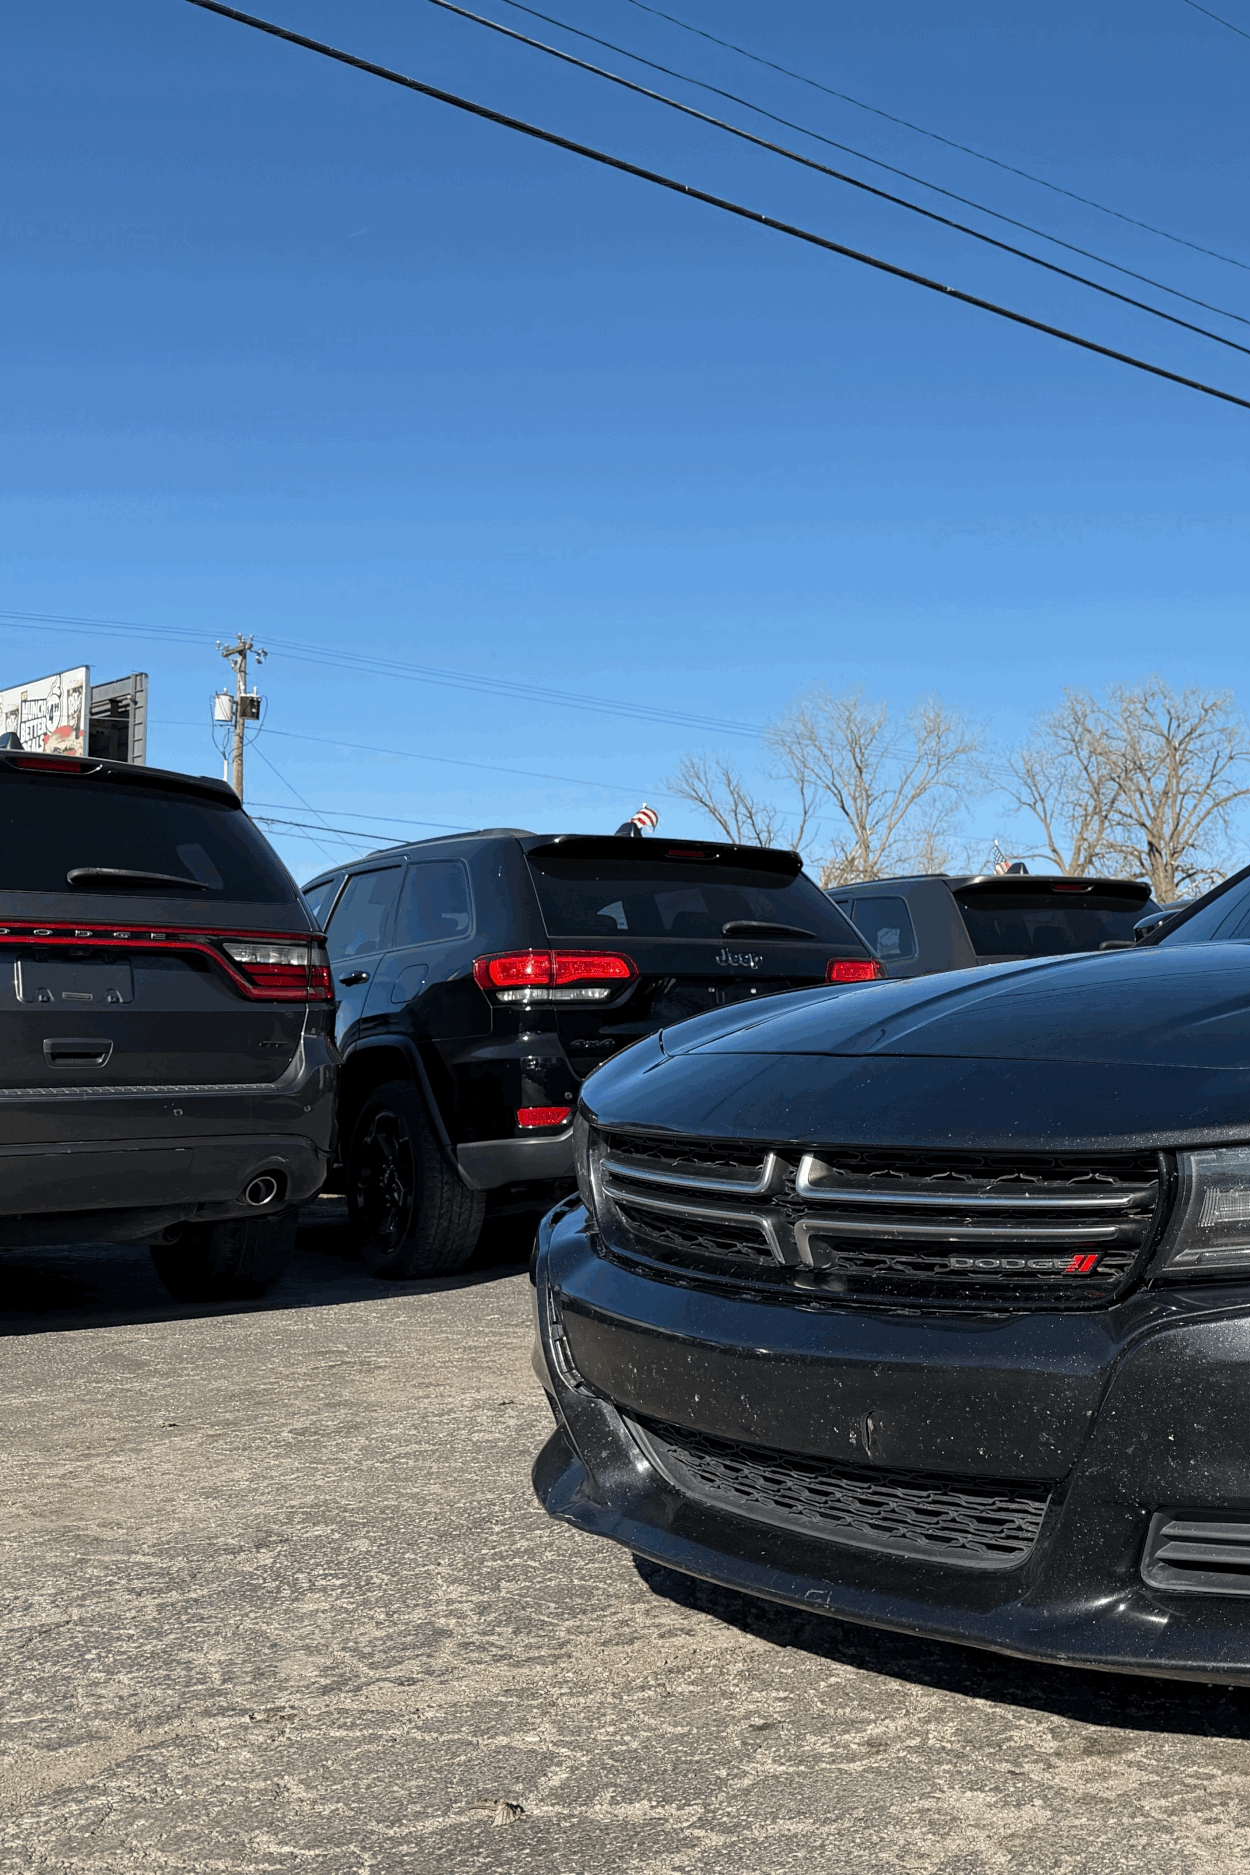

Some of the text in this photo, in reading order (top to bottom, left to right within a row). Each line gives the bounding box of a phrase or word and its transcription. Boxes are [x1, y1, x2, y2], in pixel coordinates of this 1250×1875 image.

[21, 700, 46, 723] MUNCH
[21, 717, 46, 743] BETTER
[716, 951, 763, 969] Jeep
[949, 1257, 1079, 1270] DODGE
